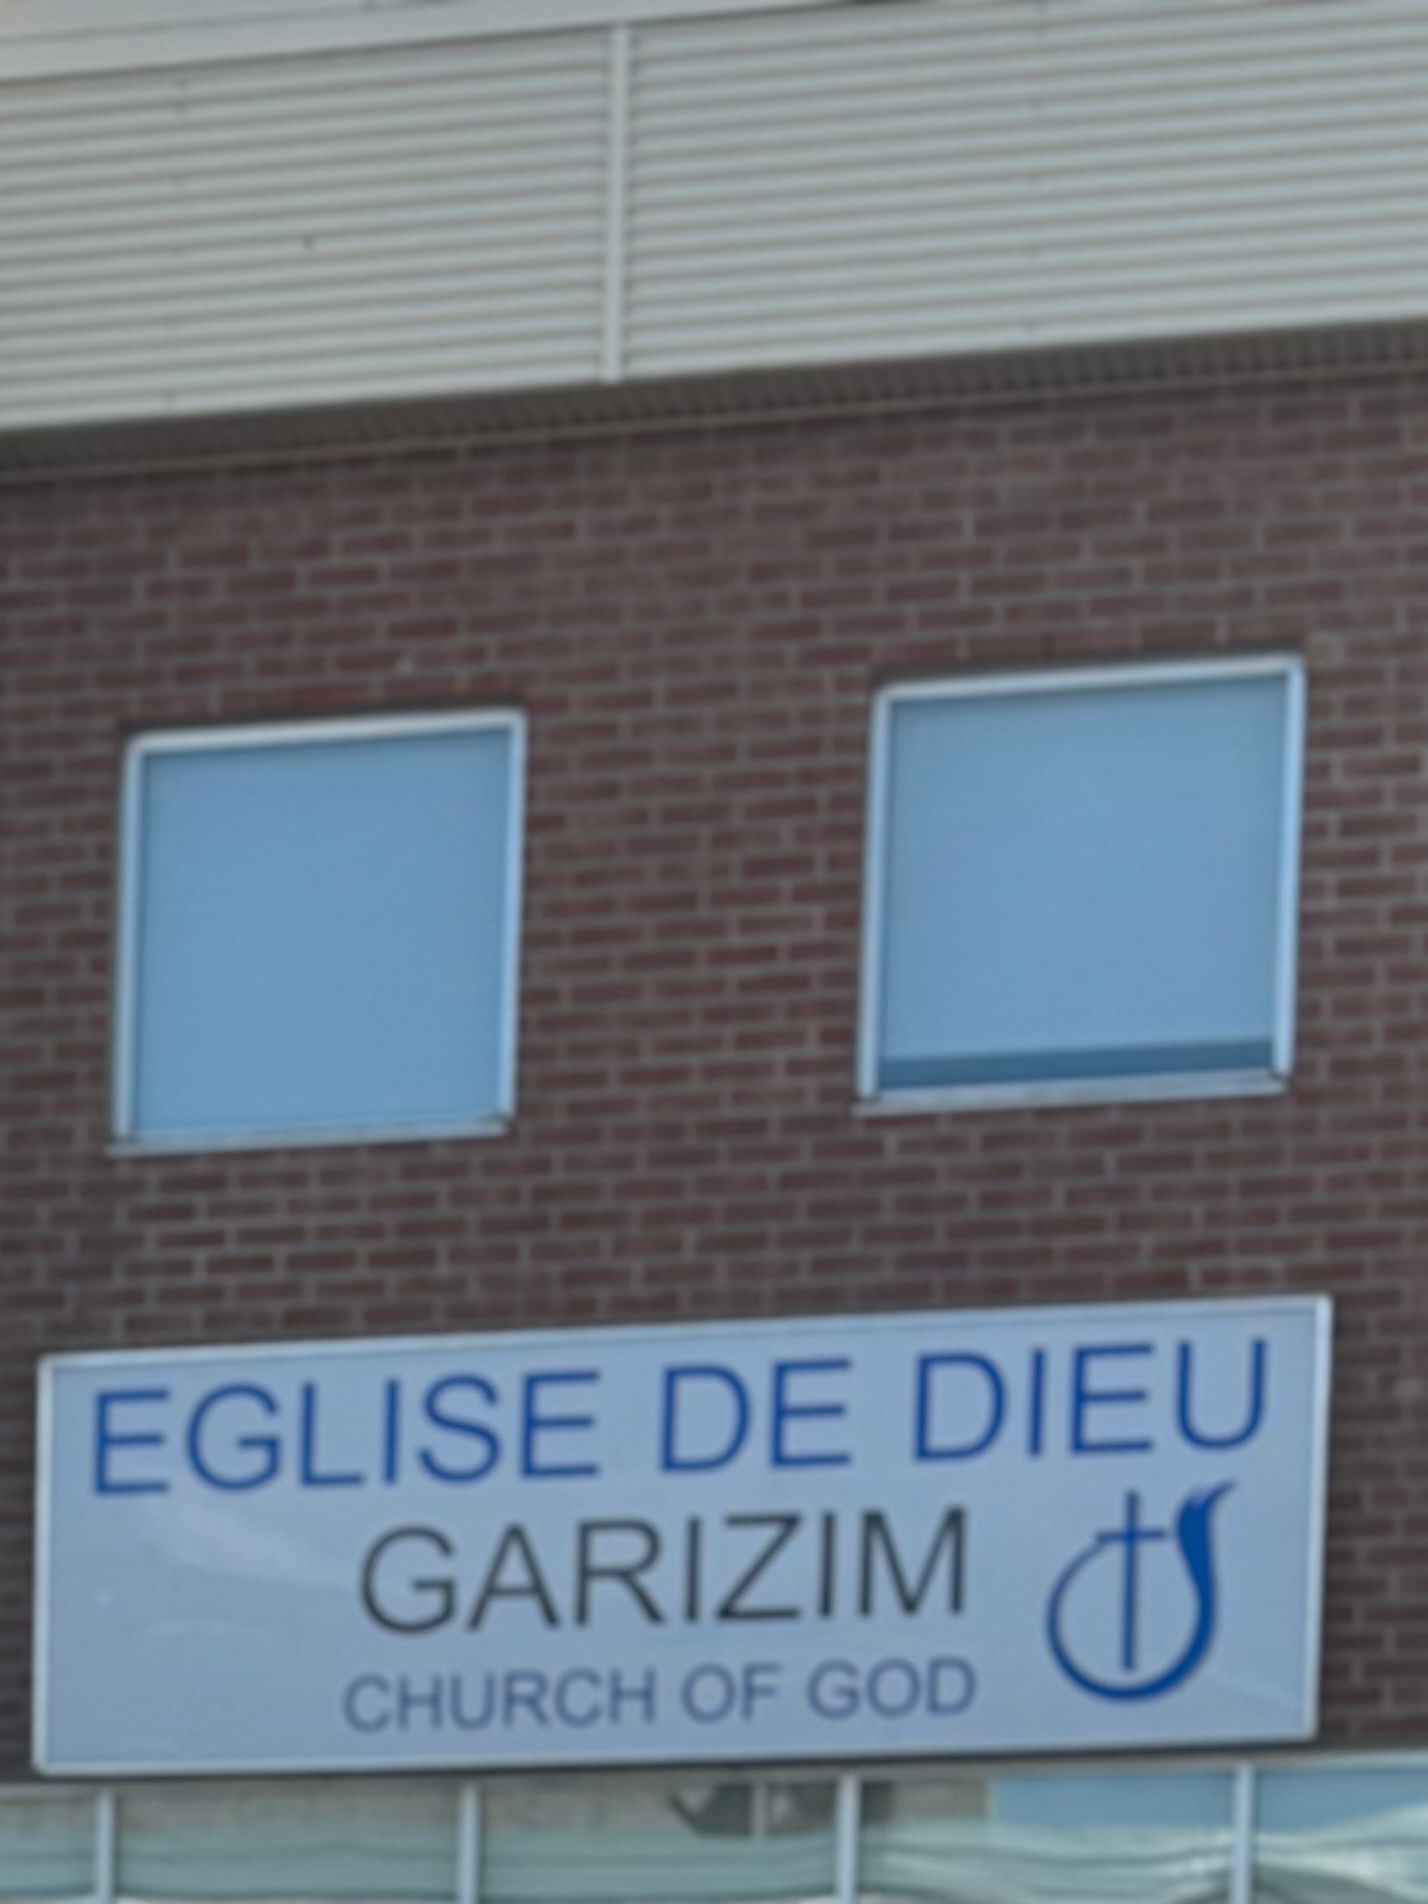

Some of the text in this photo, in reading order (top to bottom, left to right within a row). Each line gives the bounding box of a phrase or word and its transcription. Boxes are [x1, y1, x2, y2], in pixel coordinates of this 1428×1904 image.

[93, 1337, 1268, 1497] EGLISE DE DIEU
[359, 1504, 968, 1635] GARIZIM
[342, 1655, 978, 1734] CHURCH OF GOD
